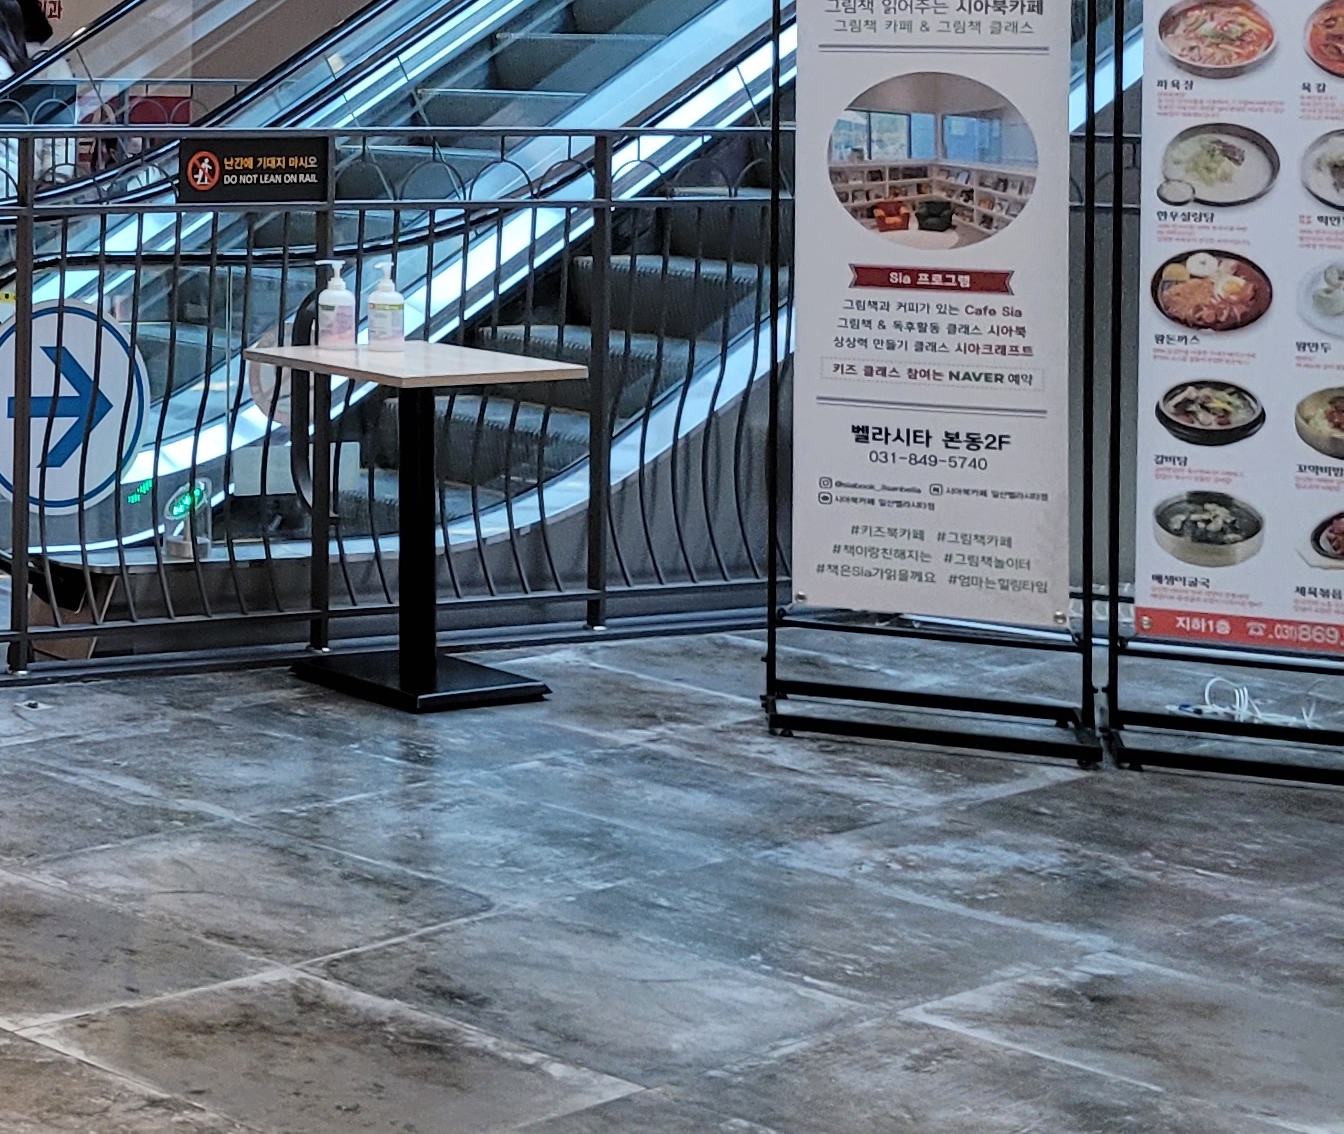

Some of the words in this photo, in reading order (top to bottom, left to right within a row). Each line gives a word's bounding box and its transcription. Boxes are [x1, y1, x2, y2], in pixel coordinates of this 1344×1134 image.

[955, 0, 1044, 16] 시아북카페
[833, 19, 877, 33] 그림책
[884, 19, 912, 34] 카페
[919, 21, 930, 32] &
[936, 20, 982, 34] 그림책
[989, 20, 1034, 35] 클래스
[223, 156, 254, 170] 난간에
[256, 155, 286, 170] 기대지
[289, 155, 318, 169] 마시오
[223, 173, 238, 185] DO
[238, 173, 258, 185] NOT
[260, 172, 282, 184] LEAN
[284, 172, 297, 184] ON
[298, 172, 318, 184] RAIL
[889, 271, 911, 284] Sia
[916, 272, 971, 288] 프로그램
[842, 299, 890, 313] 그림책과
[896, 300, 930, 315] 커피가
[935, 302, 960, 316] 있는
[1002, 306, 1023, 318] Sia
[836, 318, 872, 331] 그림책
[877, 319, 886, 330] &
[946, 323, 983, 336] 클래스
[987, 324, 1027, 339] 시아북
[833, 335, 868, 349] 상상력
[872, 338, 908, 352] 만들기
[914, 340, 950, 353] 클래스
[832, 363, 857, 376] 키즈
[863, 365, 901, 379] 클래스
[907, 367, 944, 382] 참여는
[948, 370, 1004, 385] NAVER
[1007, 372, 1033, 387] 예약
[851, 424, 933, 449] 벨라시타
[941, 430, 1012, 452] 본동2F
[868, 450, 988, 471] 031-849-5740
[850, 524, 925, 542] #키즈북카페
[936, 531, 1013, 549] #그림책카페
[1175, 616, 1231, 635] 지하1층
